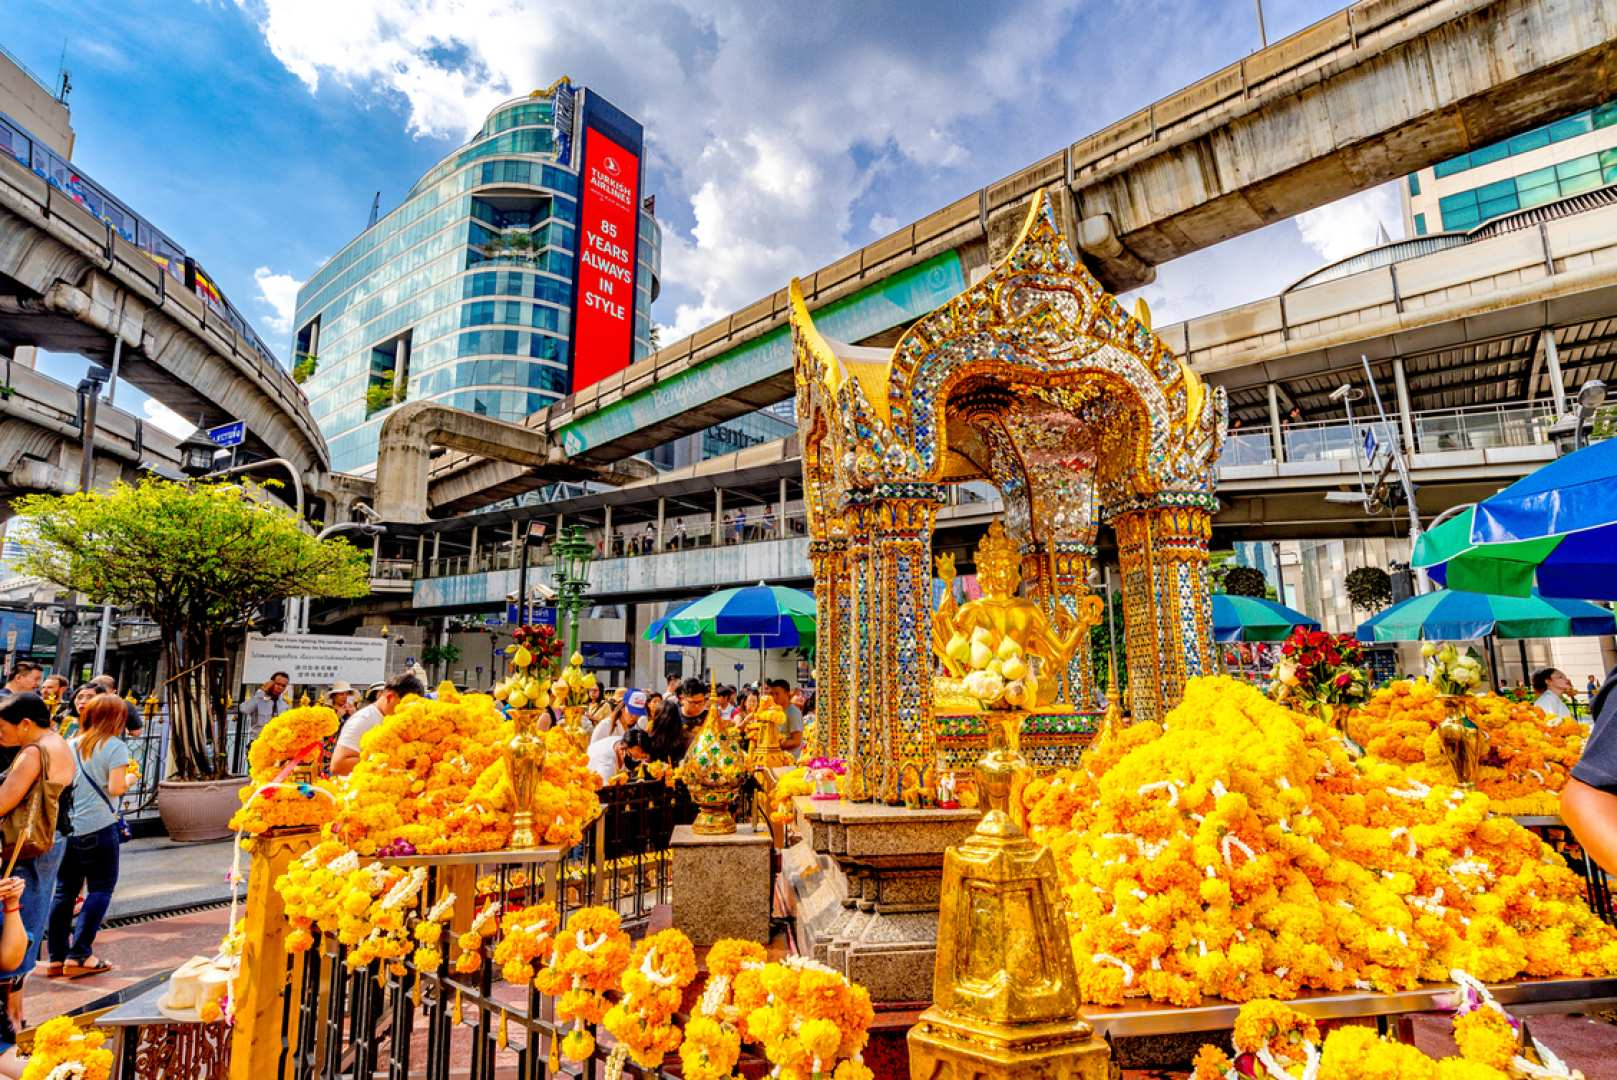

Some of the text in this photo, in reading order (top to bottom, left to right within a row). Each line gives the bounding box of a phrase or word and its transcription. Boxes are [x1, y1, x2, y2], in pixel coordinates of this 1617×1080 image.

[590, 177, 631, 205] AIRLINES
[591, 167, 631, 196] TURKISH
[601, 219, 617, 238] 85
[587, 230, 629, 264] YEARS
[581, 250, 631, 284] ALWAYS
[599, 277, 613, 295] IN
[585, 291, 625, 321] STYLE
[651, 374, 707, 407] Bangkok
